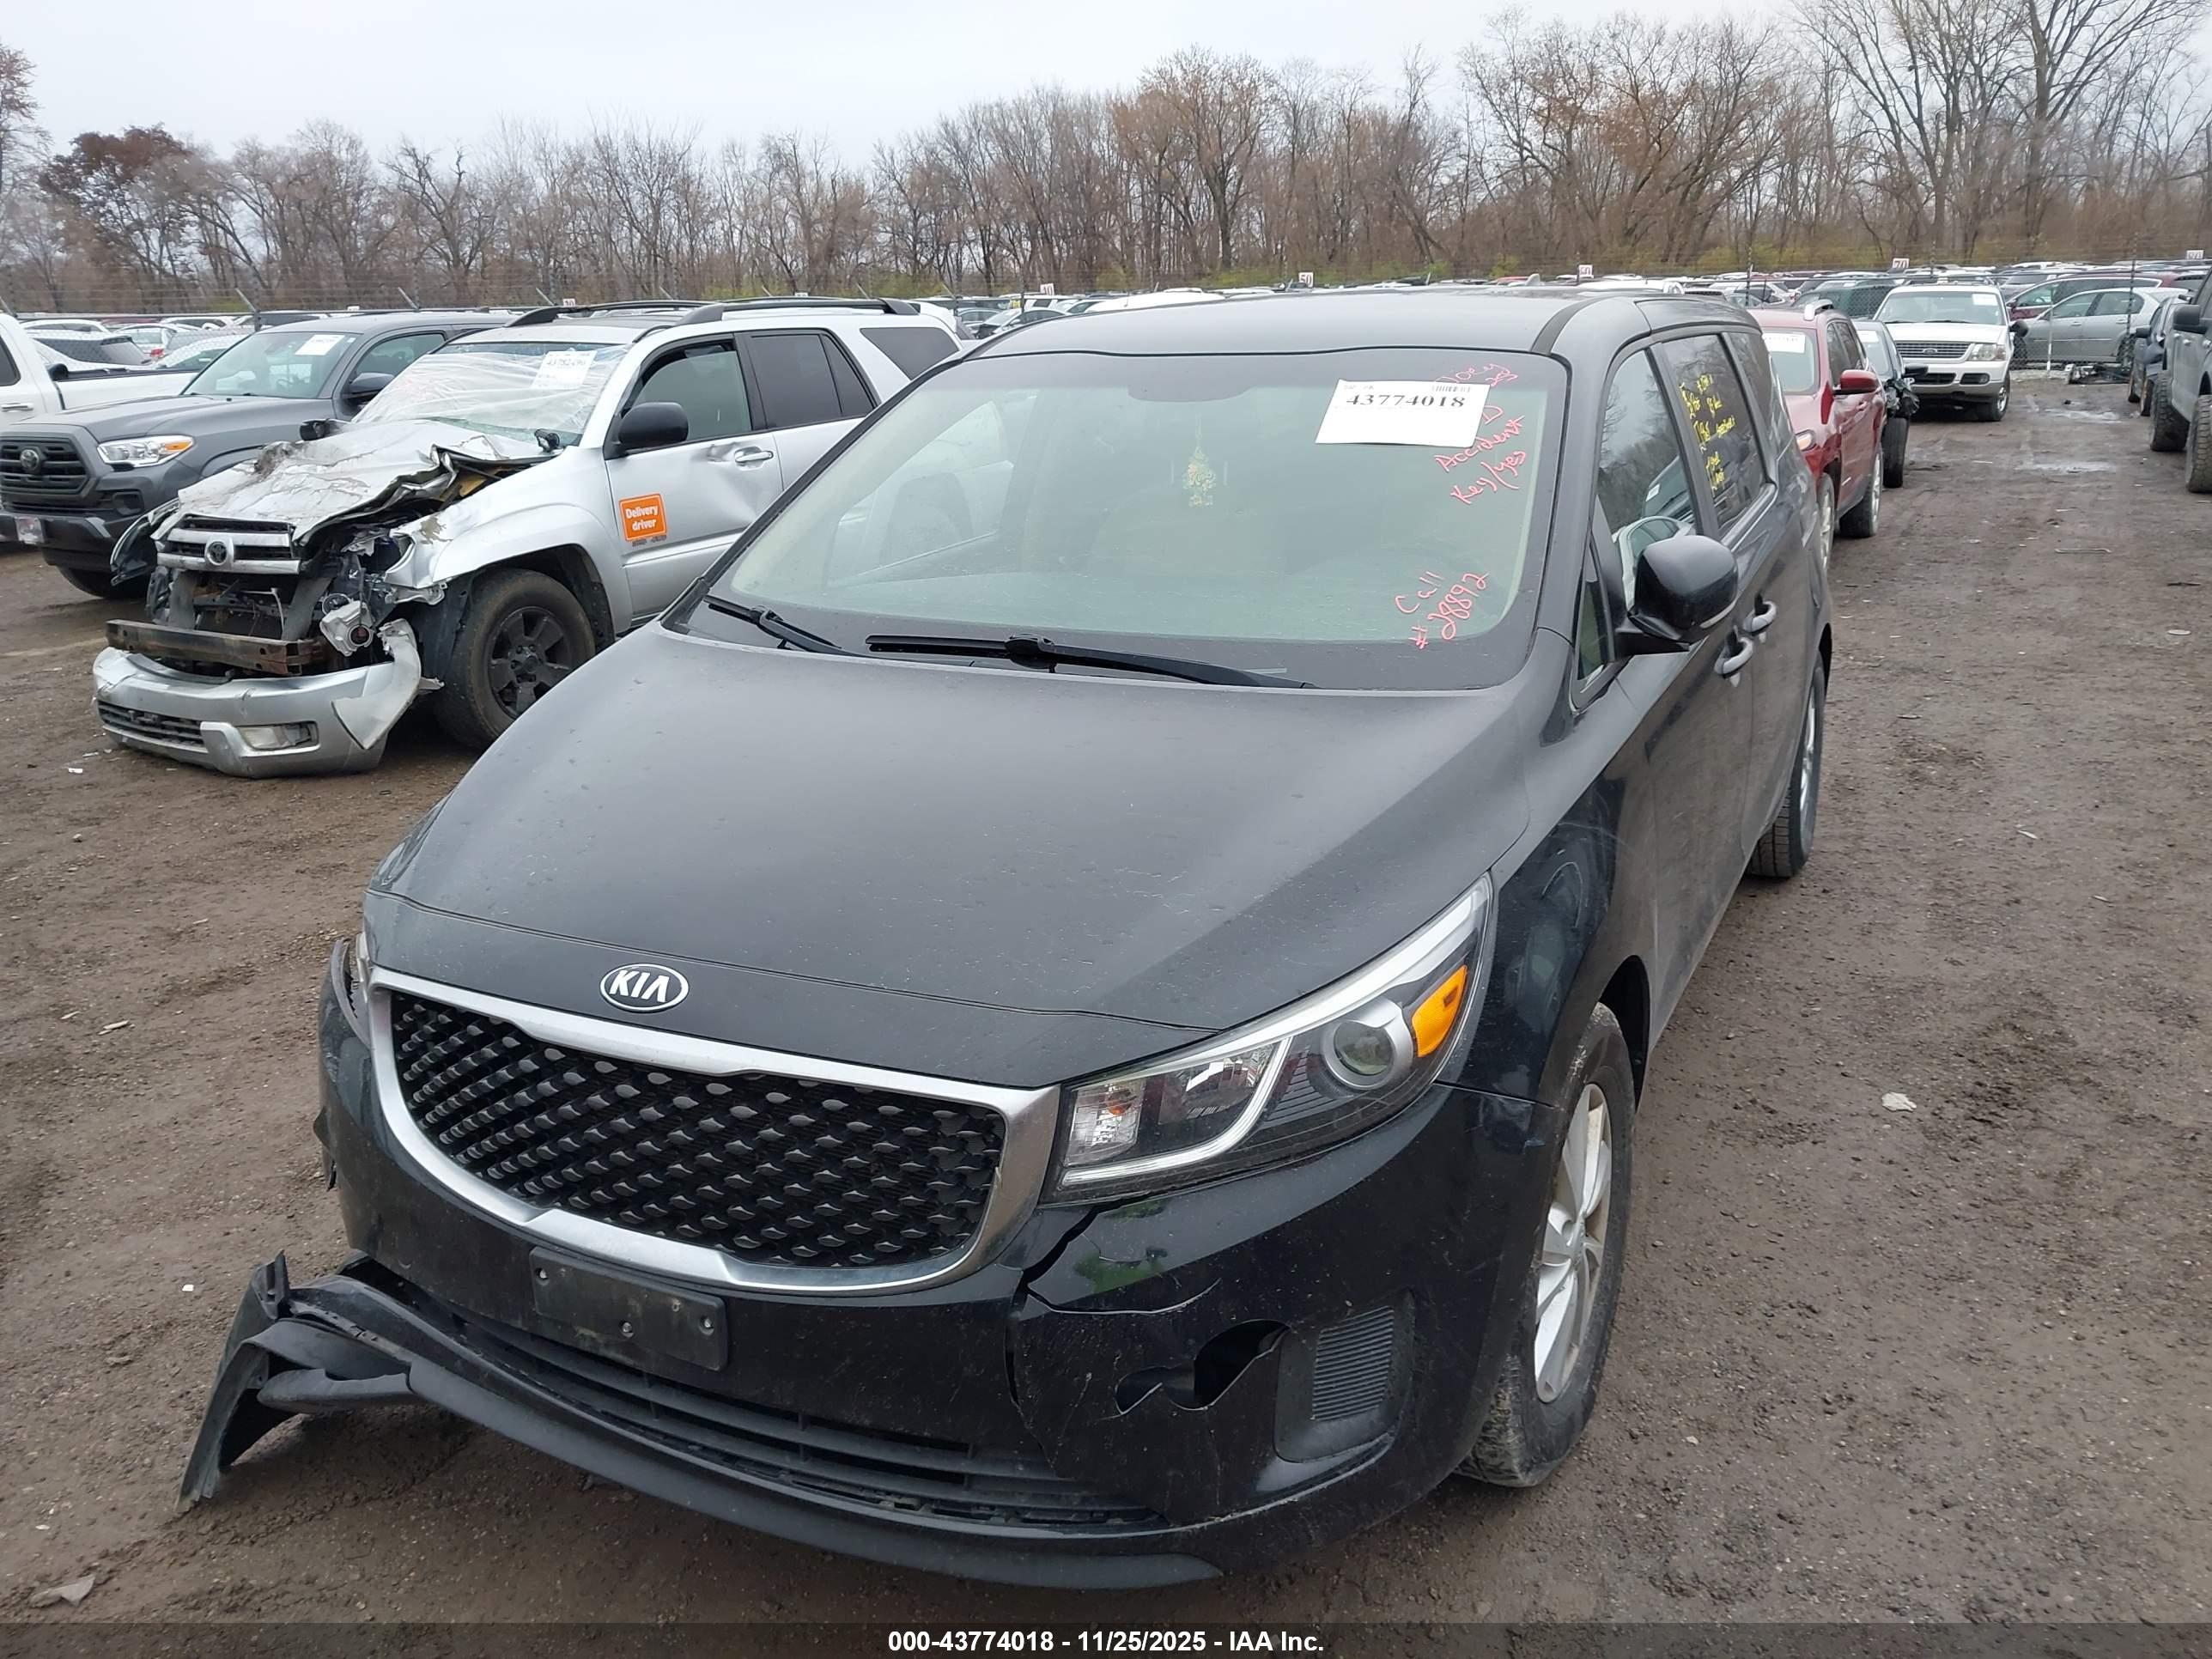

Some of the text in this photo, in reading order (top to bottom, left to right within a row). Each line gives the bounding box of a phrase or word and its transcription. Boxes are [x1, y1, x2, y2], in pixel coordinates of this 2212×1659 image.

[1300, 274, 1312, 284] 50
[1346, 393, 1466, 408] 43774018
[625, 505, 659, 520] Delivery
[632, 519, 657, 532] driver
[609, 969, 670, 1003] KIA
